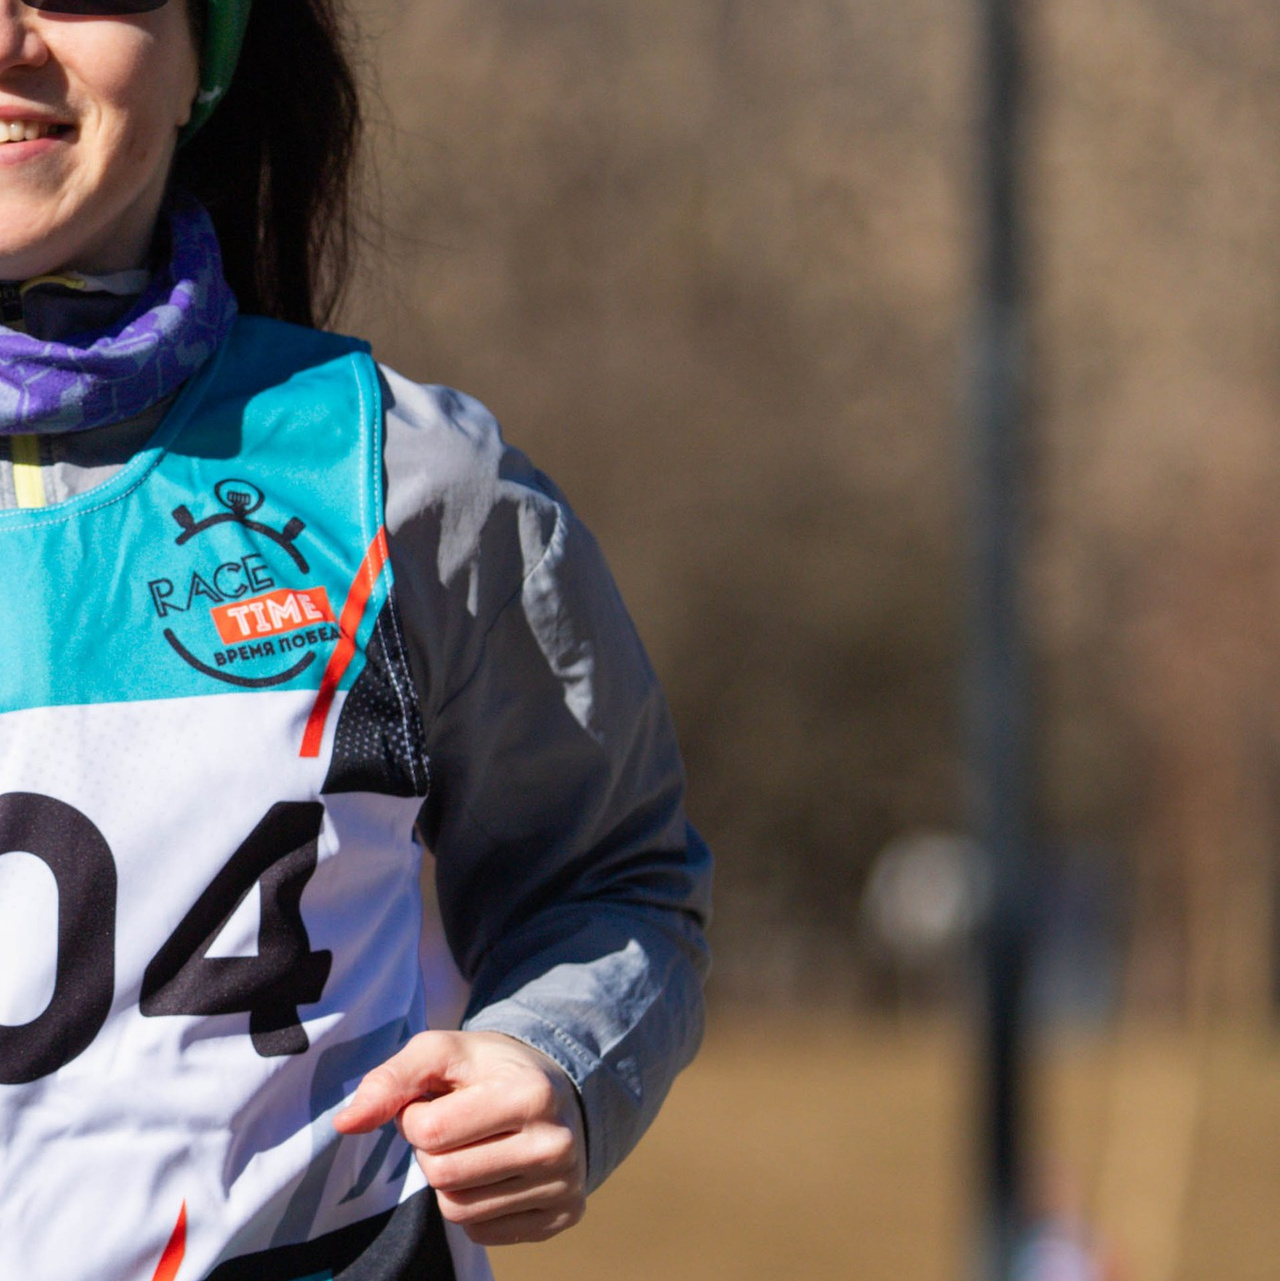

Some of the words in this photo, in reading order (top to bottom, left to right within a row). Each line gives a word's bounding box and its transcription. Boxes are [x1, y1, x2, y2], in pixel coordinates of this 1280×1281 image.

[148, 552, 275, 618] RACE
[226, 592, 323, 636] TIME
[213, 640, 275, 666] ВРЕМЯ
